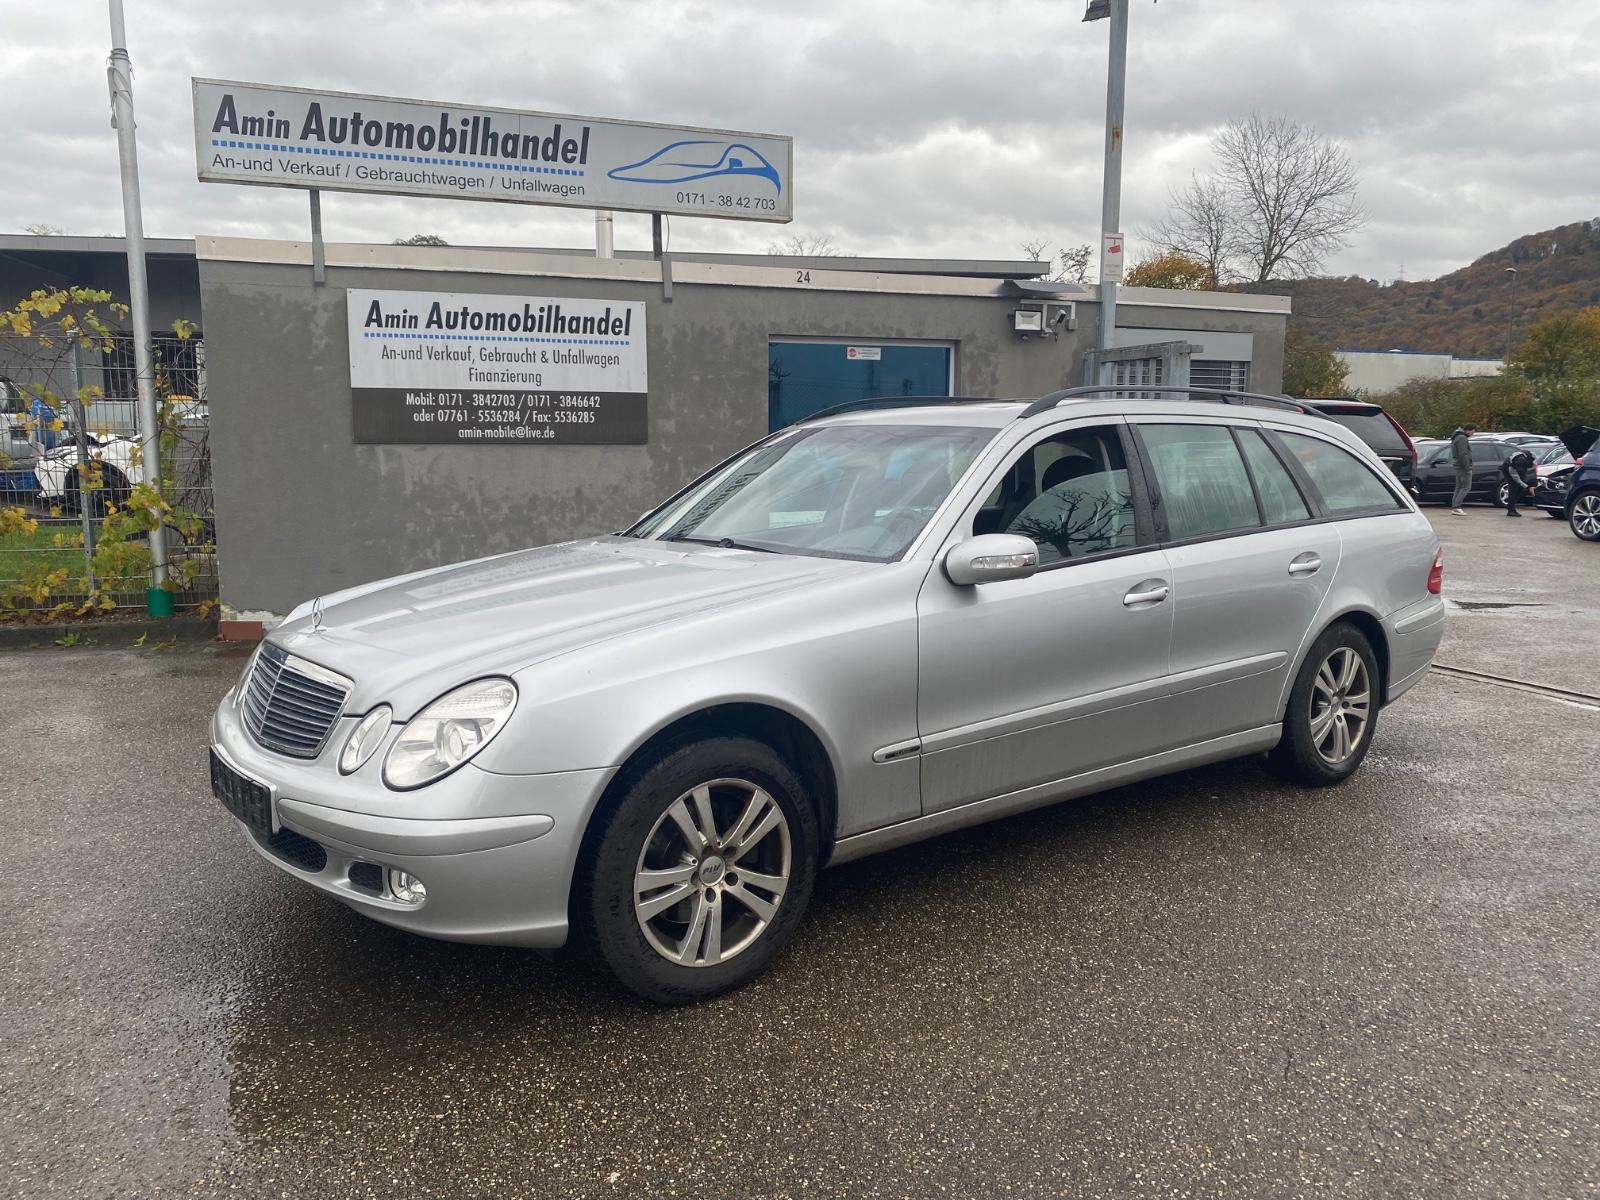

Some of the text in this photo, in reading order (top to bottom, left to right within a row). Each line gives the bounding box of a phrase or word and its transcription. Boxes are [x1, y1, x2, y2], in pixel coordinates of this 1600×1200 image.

[212, 94, 590, 164] Amin Automobilhandel
[212, 153, 585, 197] An-und Verkauf / Gebrauchtwagen / Unfallwagen
[676, 191, 706, 205] 0171
[718, 195, 733, 207] 38
[735, 197, 752, 209] 42
[754, 198, 776, 210] 703
[797, 270, 811, 283] 24
[364, 300, 632, 336] Amin Automobilhandel
[381, 345, 620, 368] An-und Verkauf, Gebraucht & Unfallwagen
[468, 368, 542, 386] Finanzierung
[406, 393, 435, 406] Mobil:
[438, 394, 463, 406] 0171
[472, 394, 516, 407] 3842703
[517, 394, 525, 409] /
[527, 395, 550, 407] 0171
[559, 396, 601, 408] 3846642
[413, 409, 435, 422] oder
[437, 409, 468, 422] 07761
[478, 410, 520, 423] 5536284
[522, 410, 530, 425] /
[532, 411, 551, 423] Fax:
[554, 411, 595, 423] 5536285
[458, 426, 555, 439] amin-mobile@live.de
